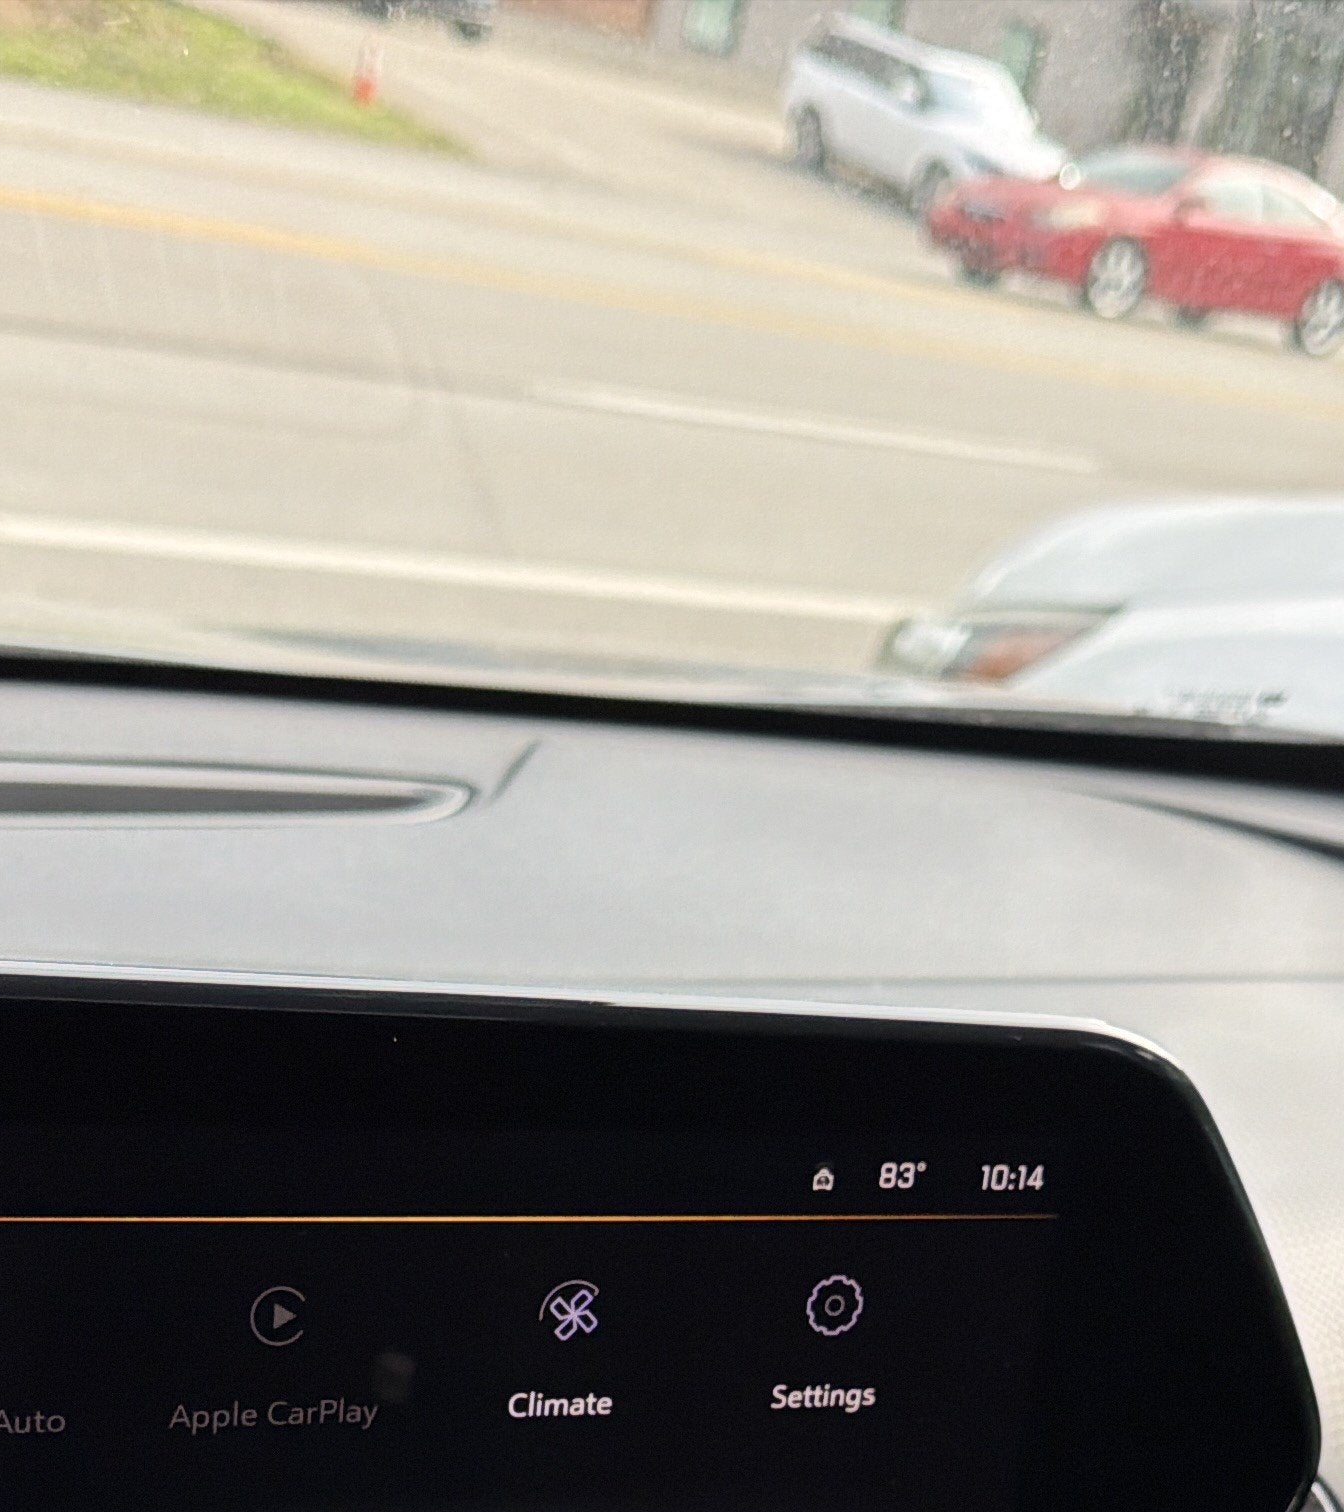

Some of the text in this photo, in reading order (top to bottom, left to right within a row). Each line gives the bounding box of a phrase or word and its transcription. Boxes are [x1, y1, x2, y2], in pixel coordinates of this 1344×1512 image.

[878, 1160, 927, 1189] 83°
[981, 1164, 1044, 1191] 10:14
[507, 1390, 613, 1418] Climate
[770, 1382, 876, 1414] Settings
[168, 1398, 379, 1435] Apple CarPlay
